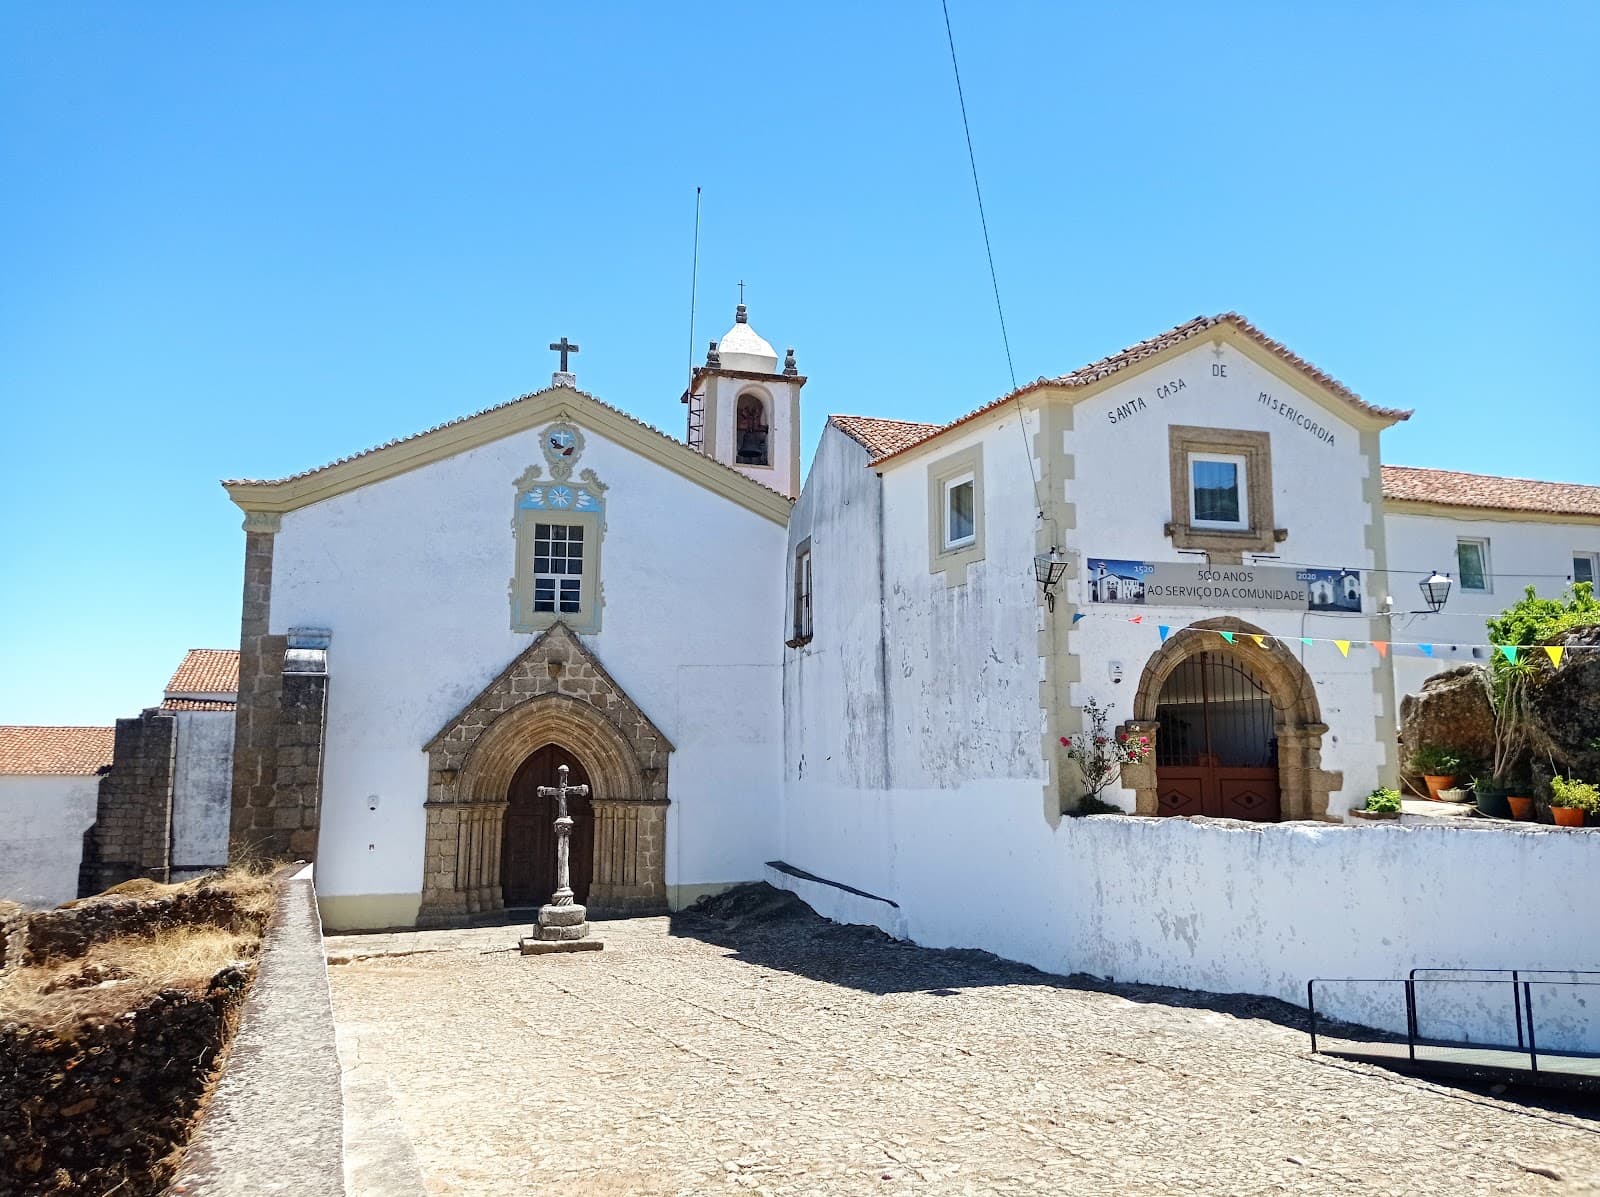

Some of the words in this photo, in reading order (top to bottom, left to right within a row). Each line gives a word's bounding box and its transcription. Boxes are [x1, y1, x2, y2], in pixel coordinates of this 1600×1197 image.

[1107, 397, 1147, 424] SANTA
[1156, 378, 1187, 400] CASA
[1212, 364, 1227, 378] DE
[1258, 391, 1335, 447] MISERICORDIA
[1133, 565, 1154, 575] 1520
[1198, 570, 1221, 582] 500
[1223, 571, 1254, 583] ANOS
[1147, 585, 1163, 596] AO
[1165, 586, 1212, 599] SERVIÇO
[1214, 587, 1230, 598] DA
[1231, 588, 1305, 601] COMUNIDADE
